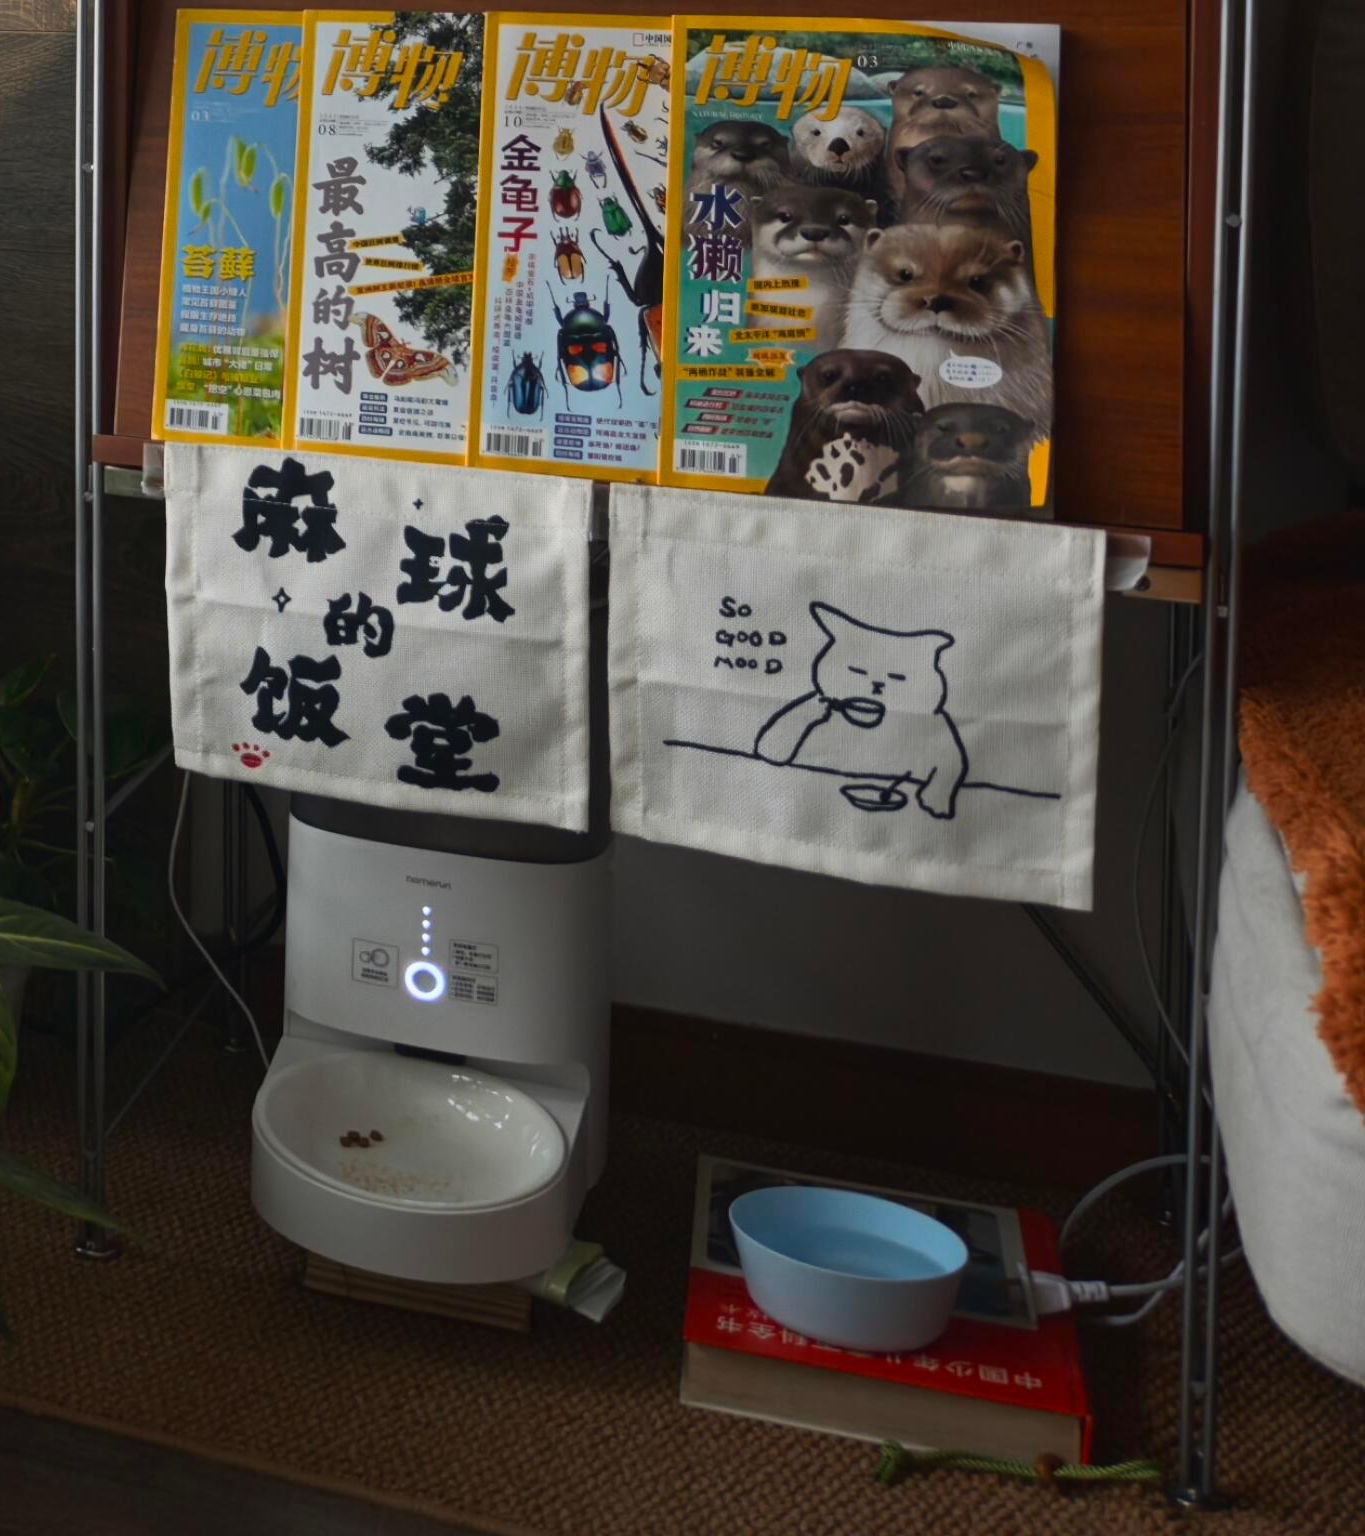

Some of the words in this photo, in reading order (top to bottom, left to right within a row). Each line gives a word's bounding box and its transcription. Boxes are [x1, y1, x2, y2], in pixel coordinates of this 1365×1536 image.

[321, 28, 464, 111] 博物
[504, 31, 655, 117] 博物
[694, 34, 854, 121] 博物
[857, 55, 878, 68] 03
[318, 122, 336, 136] 08
[504, 115, 523, 129] 10
[498, 134, 543, 252] 金龟子
[182, 245, 257, 281] 苔藓
[302, 156, 368, 395] 最高的树
[685, 184, 745, 358] 水獭归来
[322, 590, 394, 658] 的
[716, 1315, 1044, 1390] 中国少年科全书
